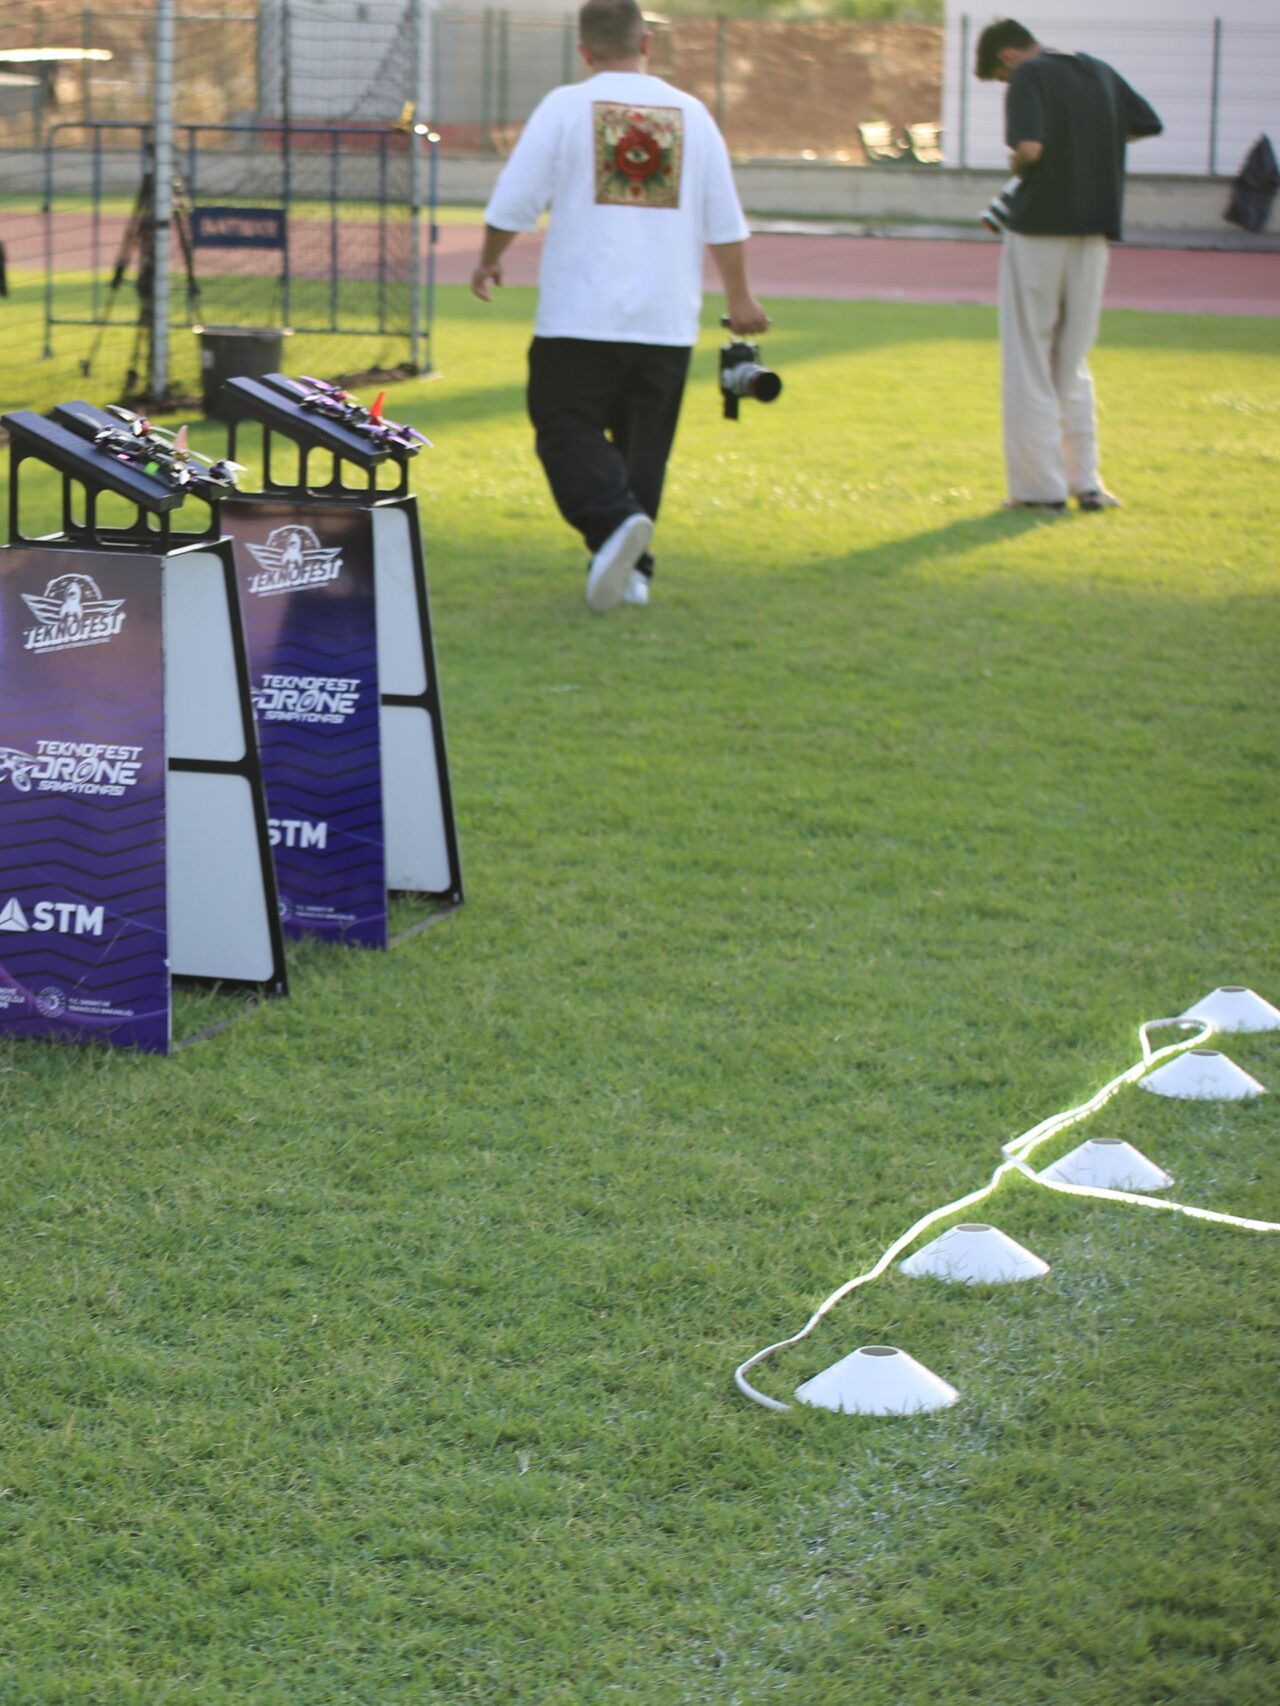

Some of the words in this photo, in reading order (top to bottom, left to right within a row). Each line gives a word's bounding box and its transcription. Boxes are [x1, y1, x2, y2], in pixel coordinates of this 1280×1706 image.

[247, 559, 343, 593] TEKNOFEST
[22, 612, 126, 650] TEKNOFEST
[261, 674, 362, 692] TEKNOFEST
[257, 689, 360, 714] DRONE
[36, 740, 144, 761] TEKNOFEST
[30, 756, 143, 786] DRONE
[267, 818, 327, 849] STM
[32, 901, 105, 936] STM
